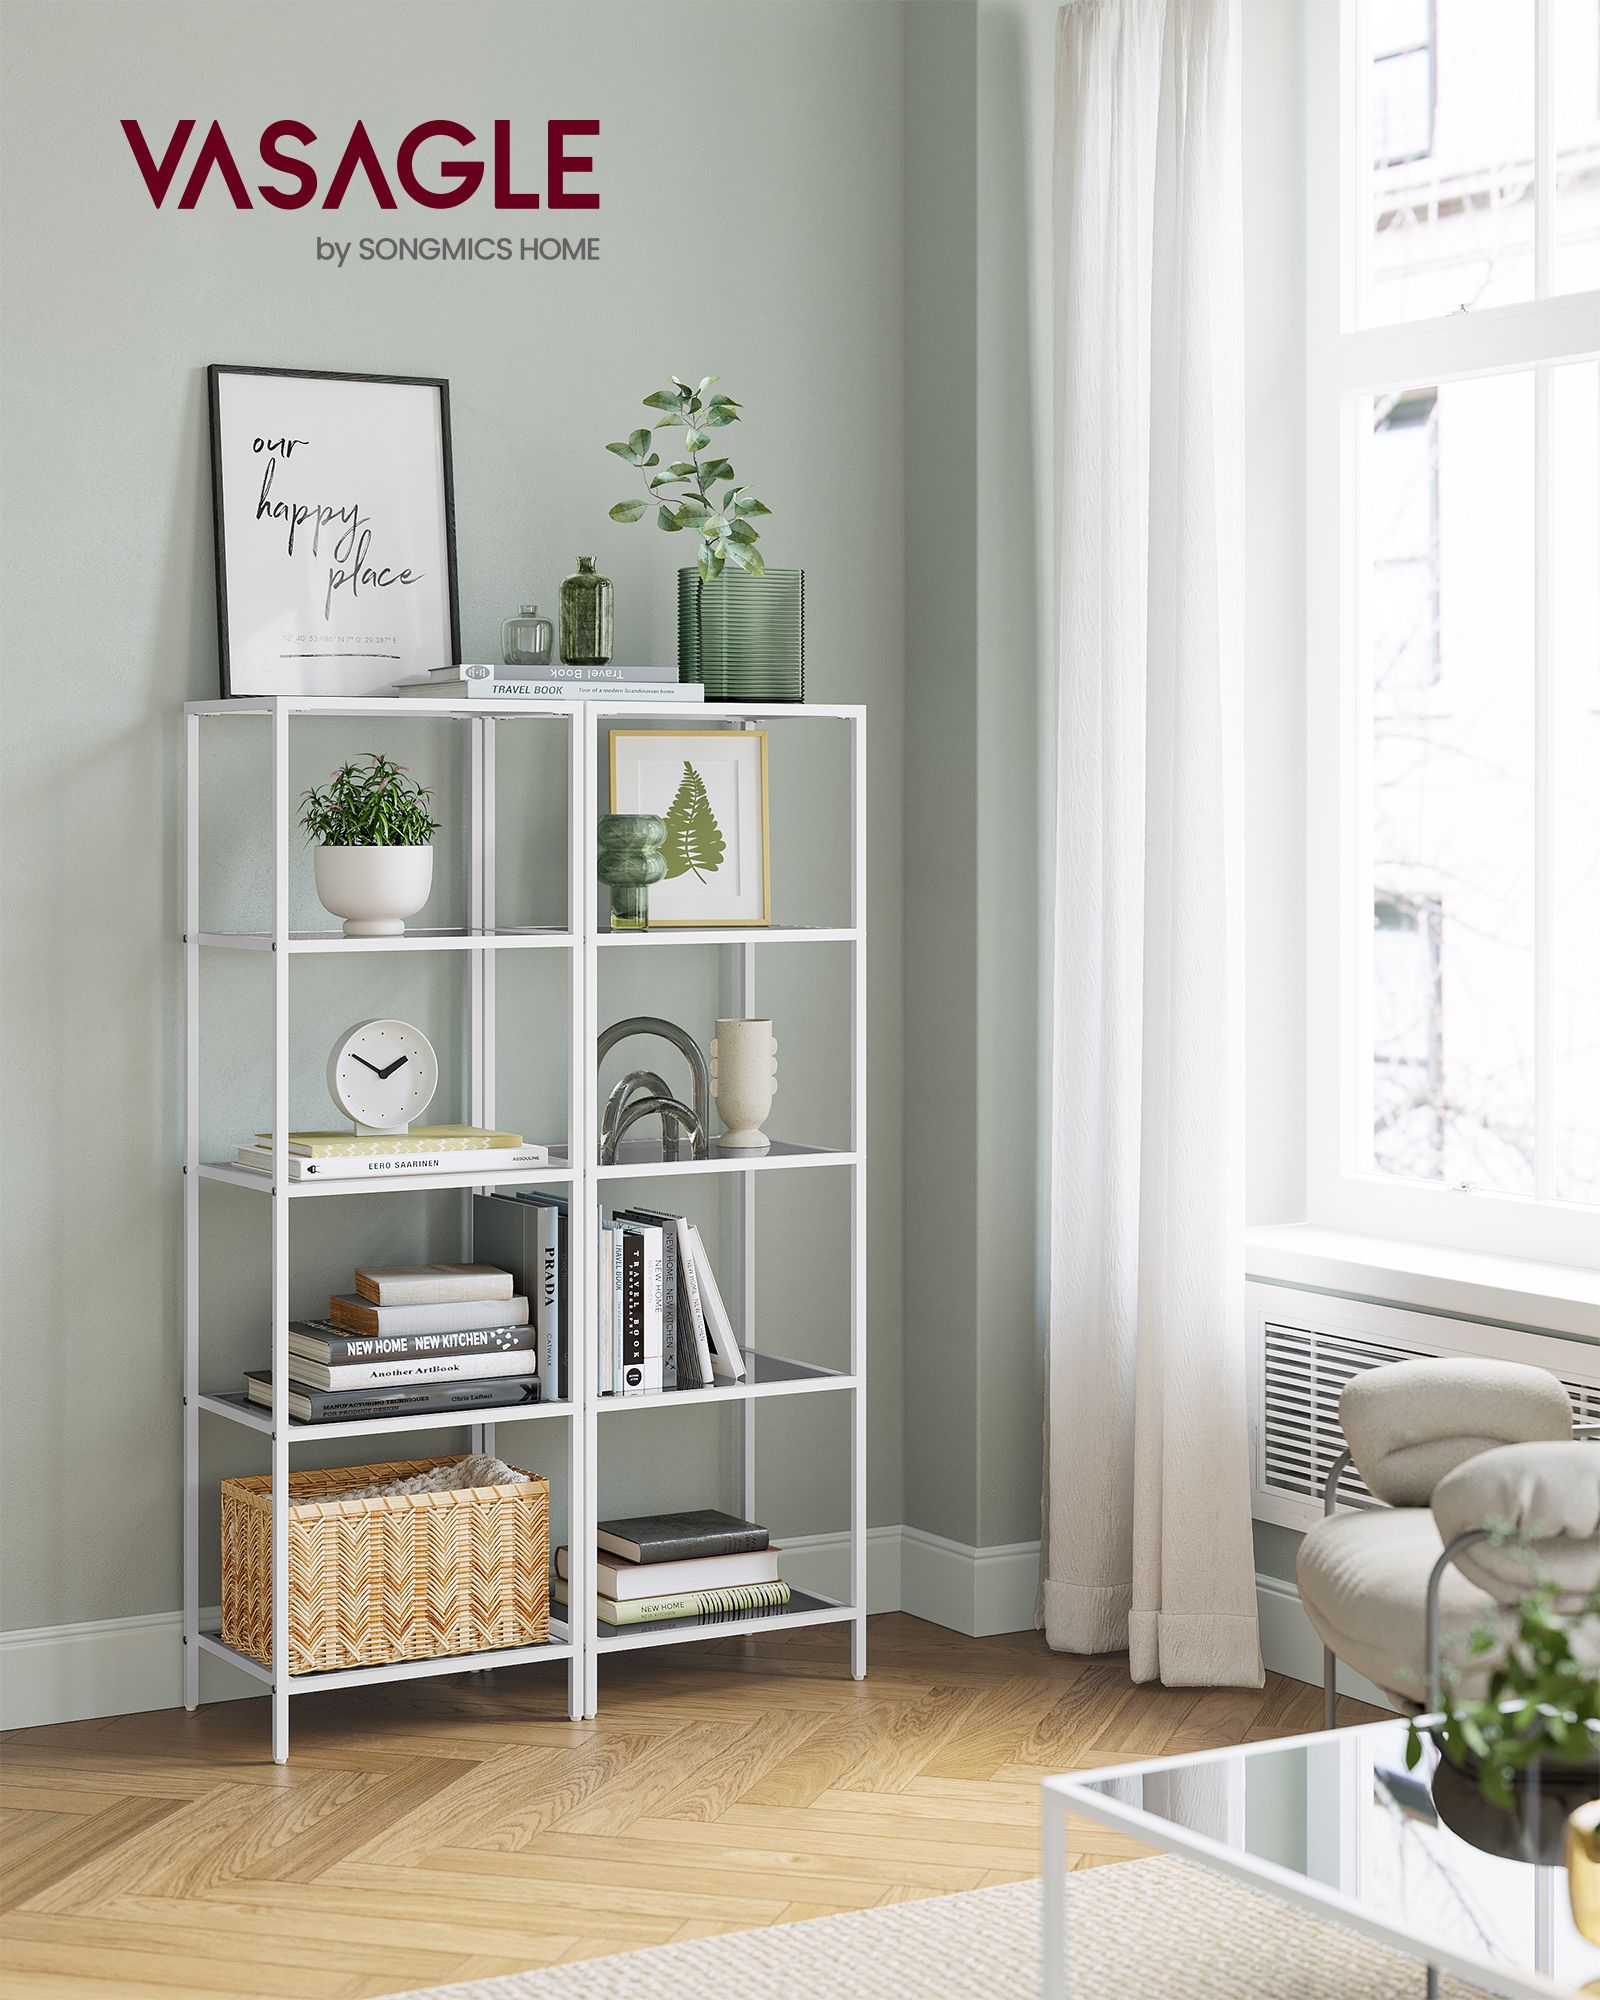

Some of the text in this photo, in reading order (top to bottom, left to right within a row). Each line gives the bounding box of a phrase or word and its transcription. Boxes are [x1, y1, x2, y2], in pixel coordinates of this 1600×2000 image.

[252, 436, 309, 458] our
[256, 457, 371, 563] happy
[324, 529, 427, 621] place
[550, 668, 624, 680] Travel Book
[492, 685, 563, 694] TRAVEL BOOK
[368, 1160, 439, 1170] EERO SAARINEN
[545, 1248, 555, 1306] PRADA
[347, 1331, 488, 1356] NEW HOME NEW KITCHEN
[370, 1364, 460, 1378] Another ArtBook
[323, 1400, 384, 1410] MANUFACTURING
[339, 1408, 372, 1416] PRODUCT
[661, 1602, 685, 1610] HOME
